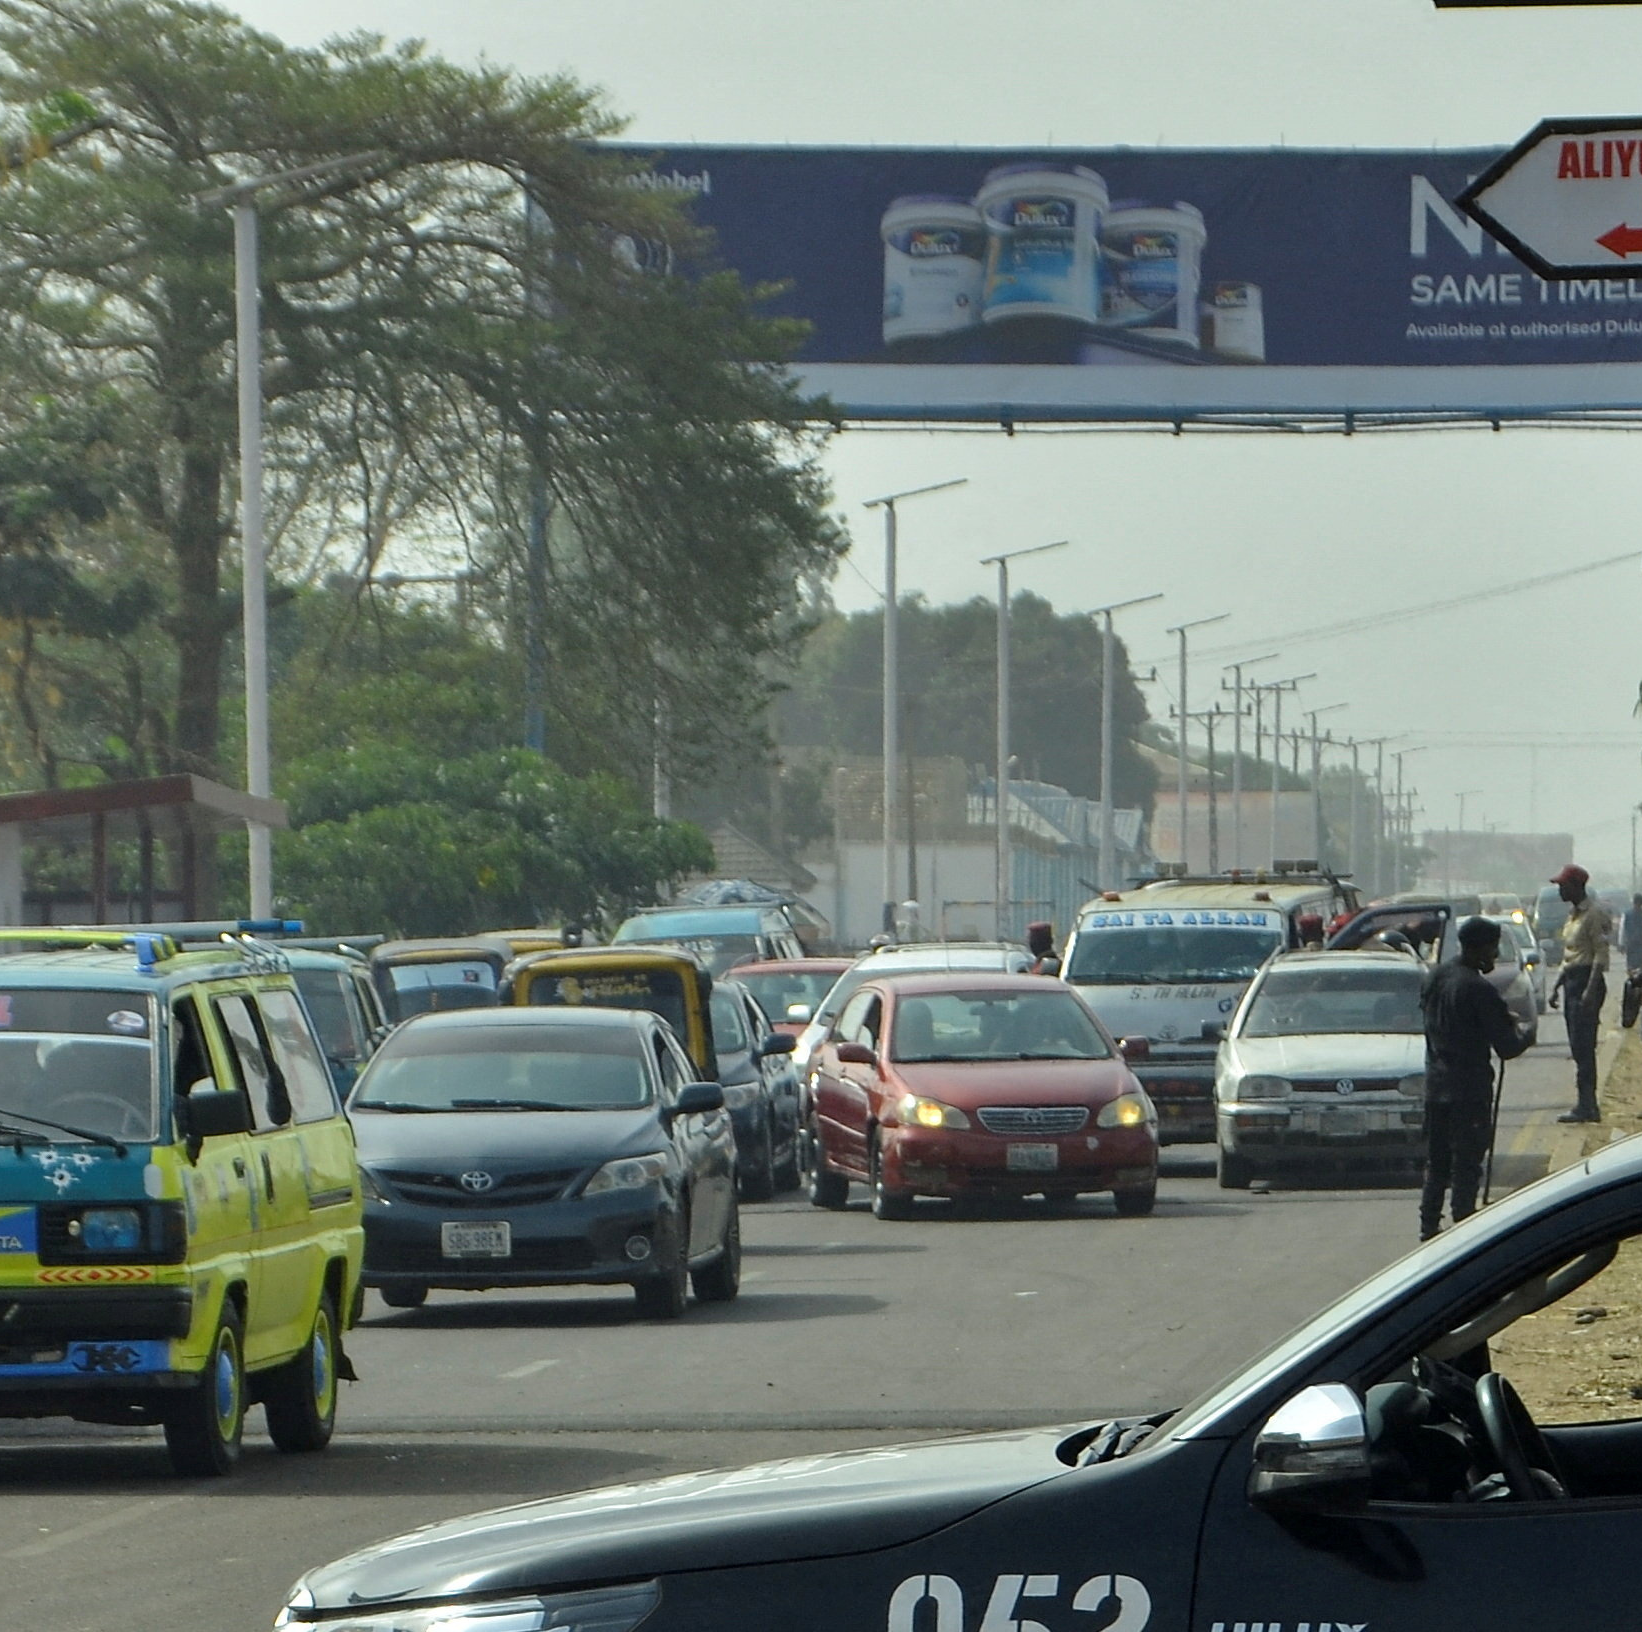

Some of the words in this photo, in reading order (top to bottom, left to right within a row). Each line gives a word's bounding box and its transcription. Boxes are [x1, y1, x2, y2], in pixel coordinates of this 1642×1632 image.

[1411, 274, 1522, 304] SAME
[1407, 321, 1484, 338] Available
[1489, 321, 1506, 336] at
[1510, 318, 1601, 337] authorised
[1092, 914, 1134, 928] SAI
[1143, 912, 1173, 926] TA
[1183, 911, 1268, 926] ALLAH
